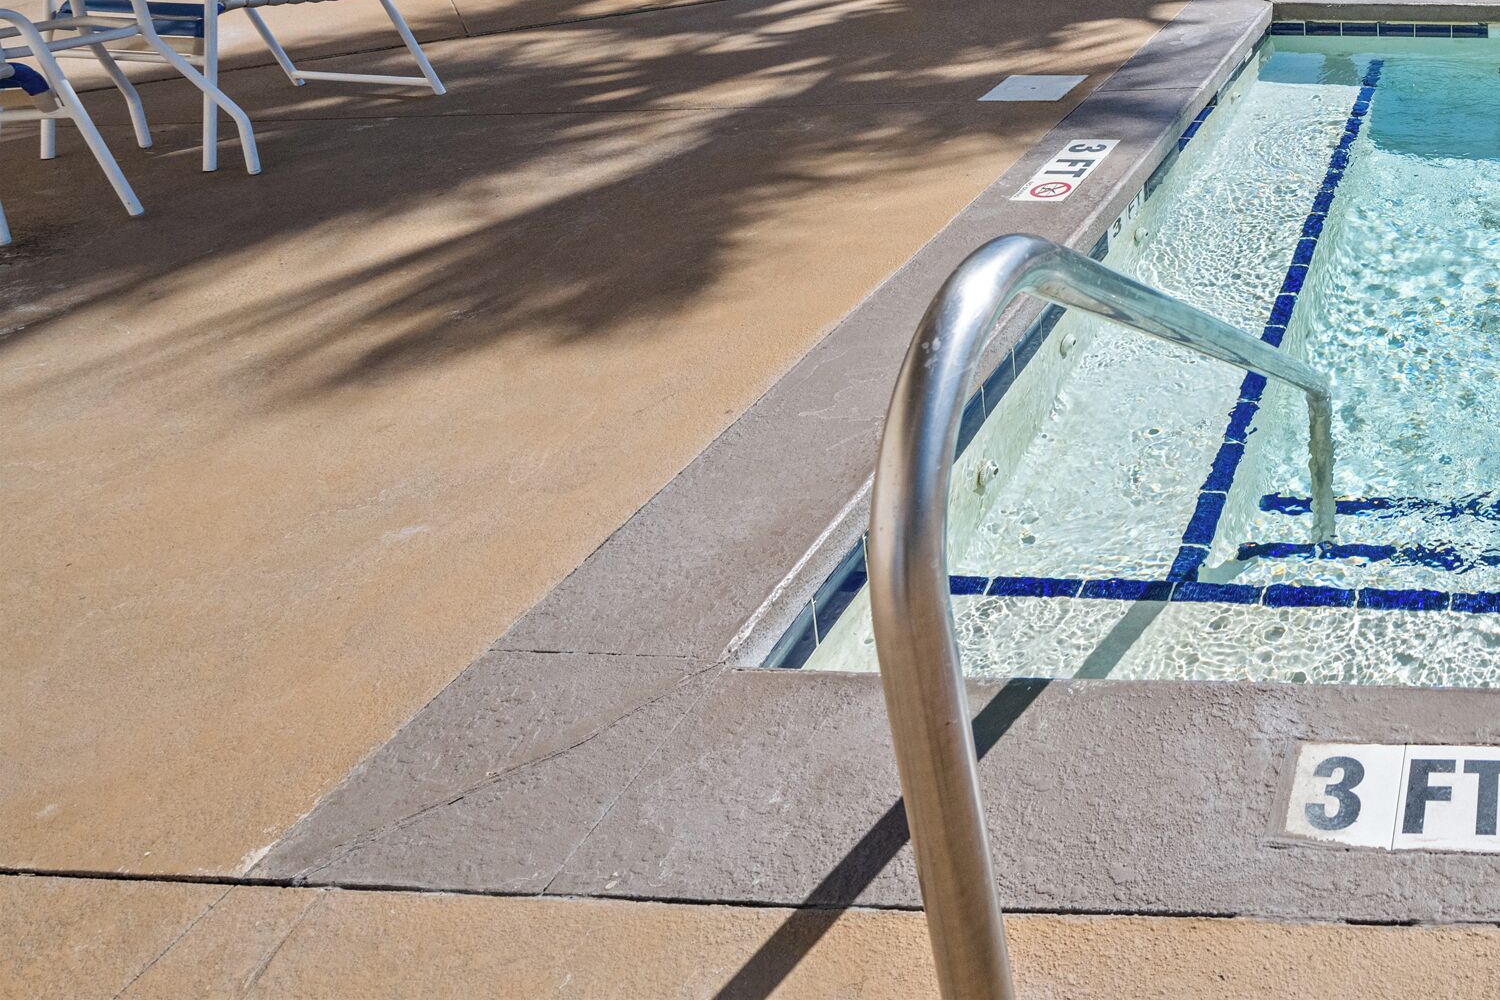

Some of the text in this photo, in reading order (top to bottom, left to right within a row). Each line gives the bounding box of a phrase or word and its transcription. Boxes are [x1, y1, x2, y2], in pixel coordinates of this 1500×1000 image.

[1044, 144, 1107, 177] 3 FT
[1113, 189, 1142, 238] 3 FT
[1304, 756, 1365, 831] 3
